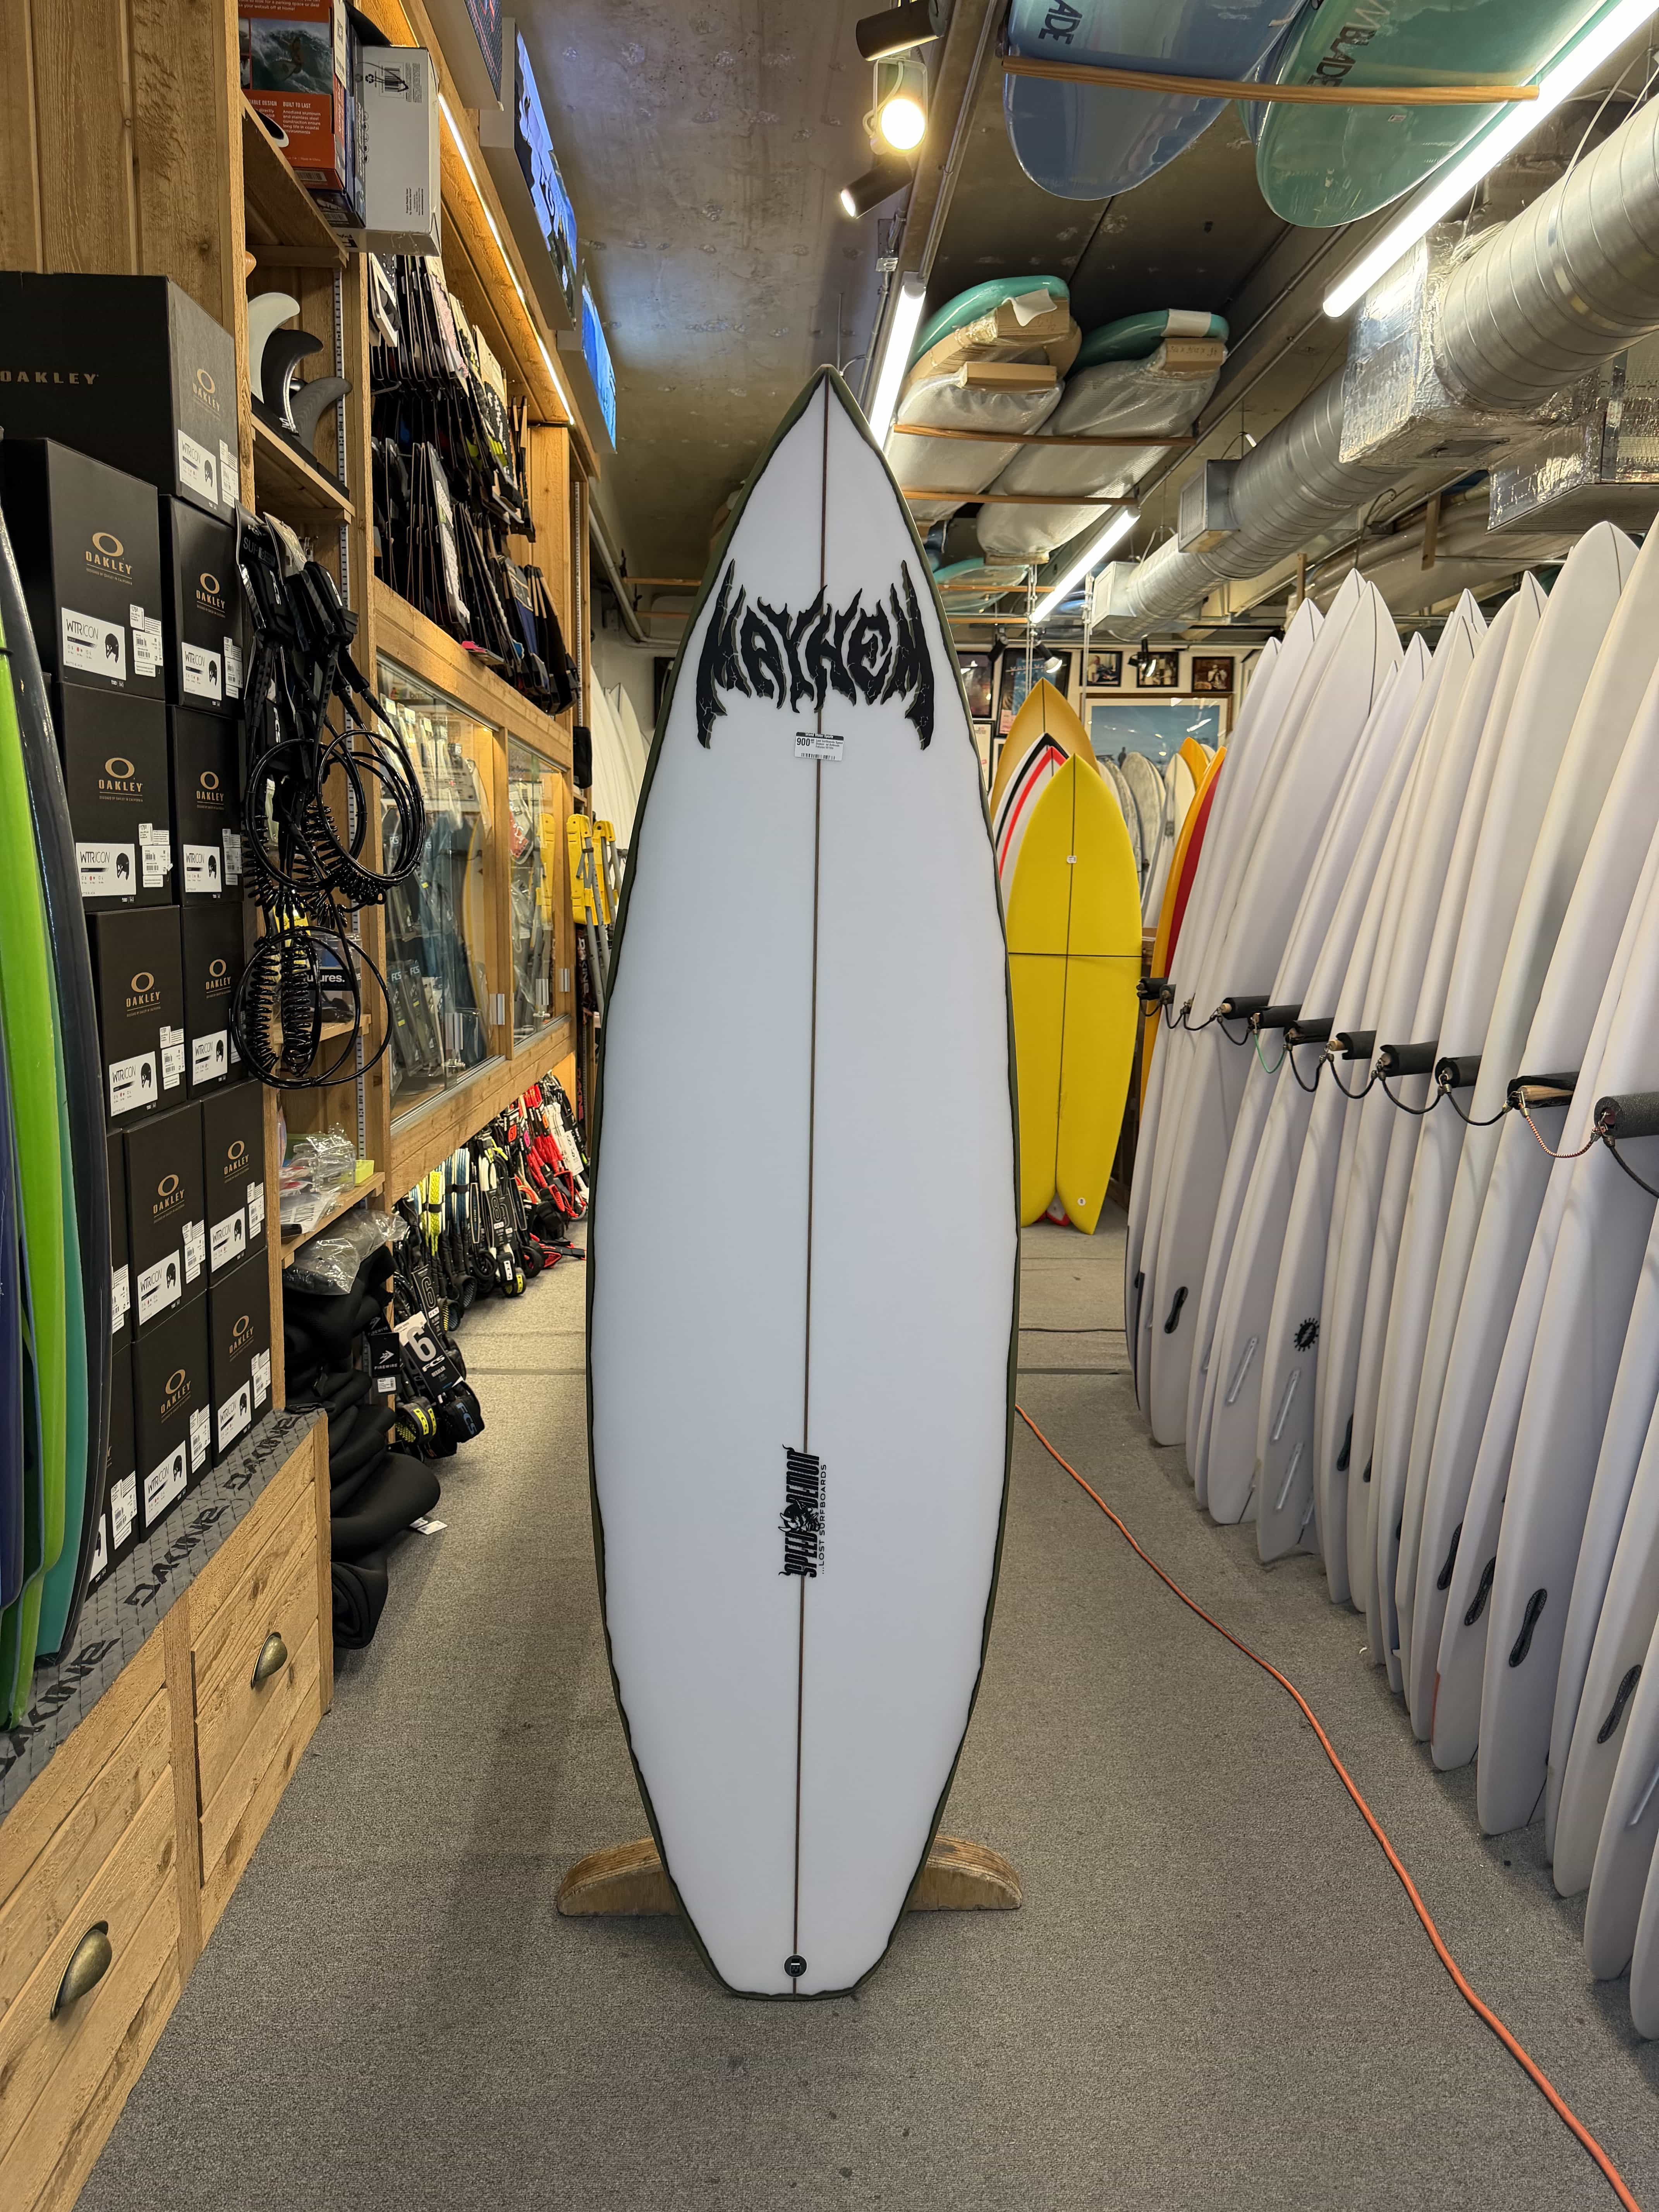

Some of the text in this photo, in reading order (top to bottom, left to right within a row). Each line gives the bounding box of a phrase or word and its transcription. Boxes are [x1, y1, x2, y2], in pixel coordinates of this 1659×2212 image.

[0, 371, 96, 385] OAKLEY
[193, 383, 220, 412] OAKLEY
[243, 537, 259, 555] SUP
[86, 551, 132, 575] OAKLEY
[196, 590, 225, 609] OAKLEY
[98, 780, 142, 792] OAKLEY
[196, 791, 224, 802] OAKLEY
[391, 971, 402, 982] FCS
[410, 965, 420, 975] FCS
[206, 977, 231, 990] OAKLEY
[126, 991, 160, 1007] OAKLEY
[224, 1154, 249, 1175] OAKLEY
[153, 1190, 185, 1214] OAKLEY
[422, 1276, 436, 1309] 6
[229, 1326, 254, 1354] OAKLEY
[407, 1326, 436, 1362] 6
[422, 1355, 445, 1372] FCS
[160, 1380, 191, 1414] OAKLEY
[456, 1402, 477, 1435] FCS
[222, 1415, 303, 1491] DAKINE
[124, 1504, 230, 1608] DAKINE
